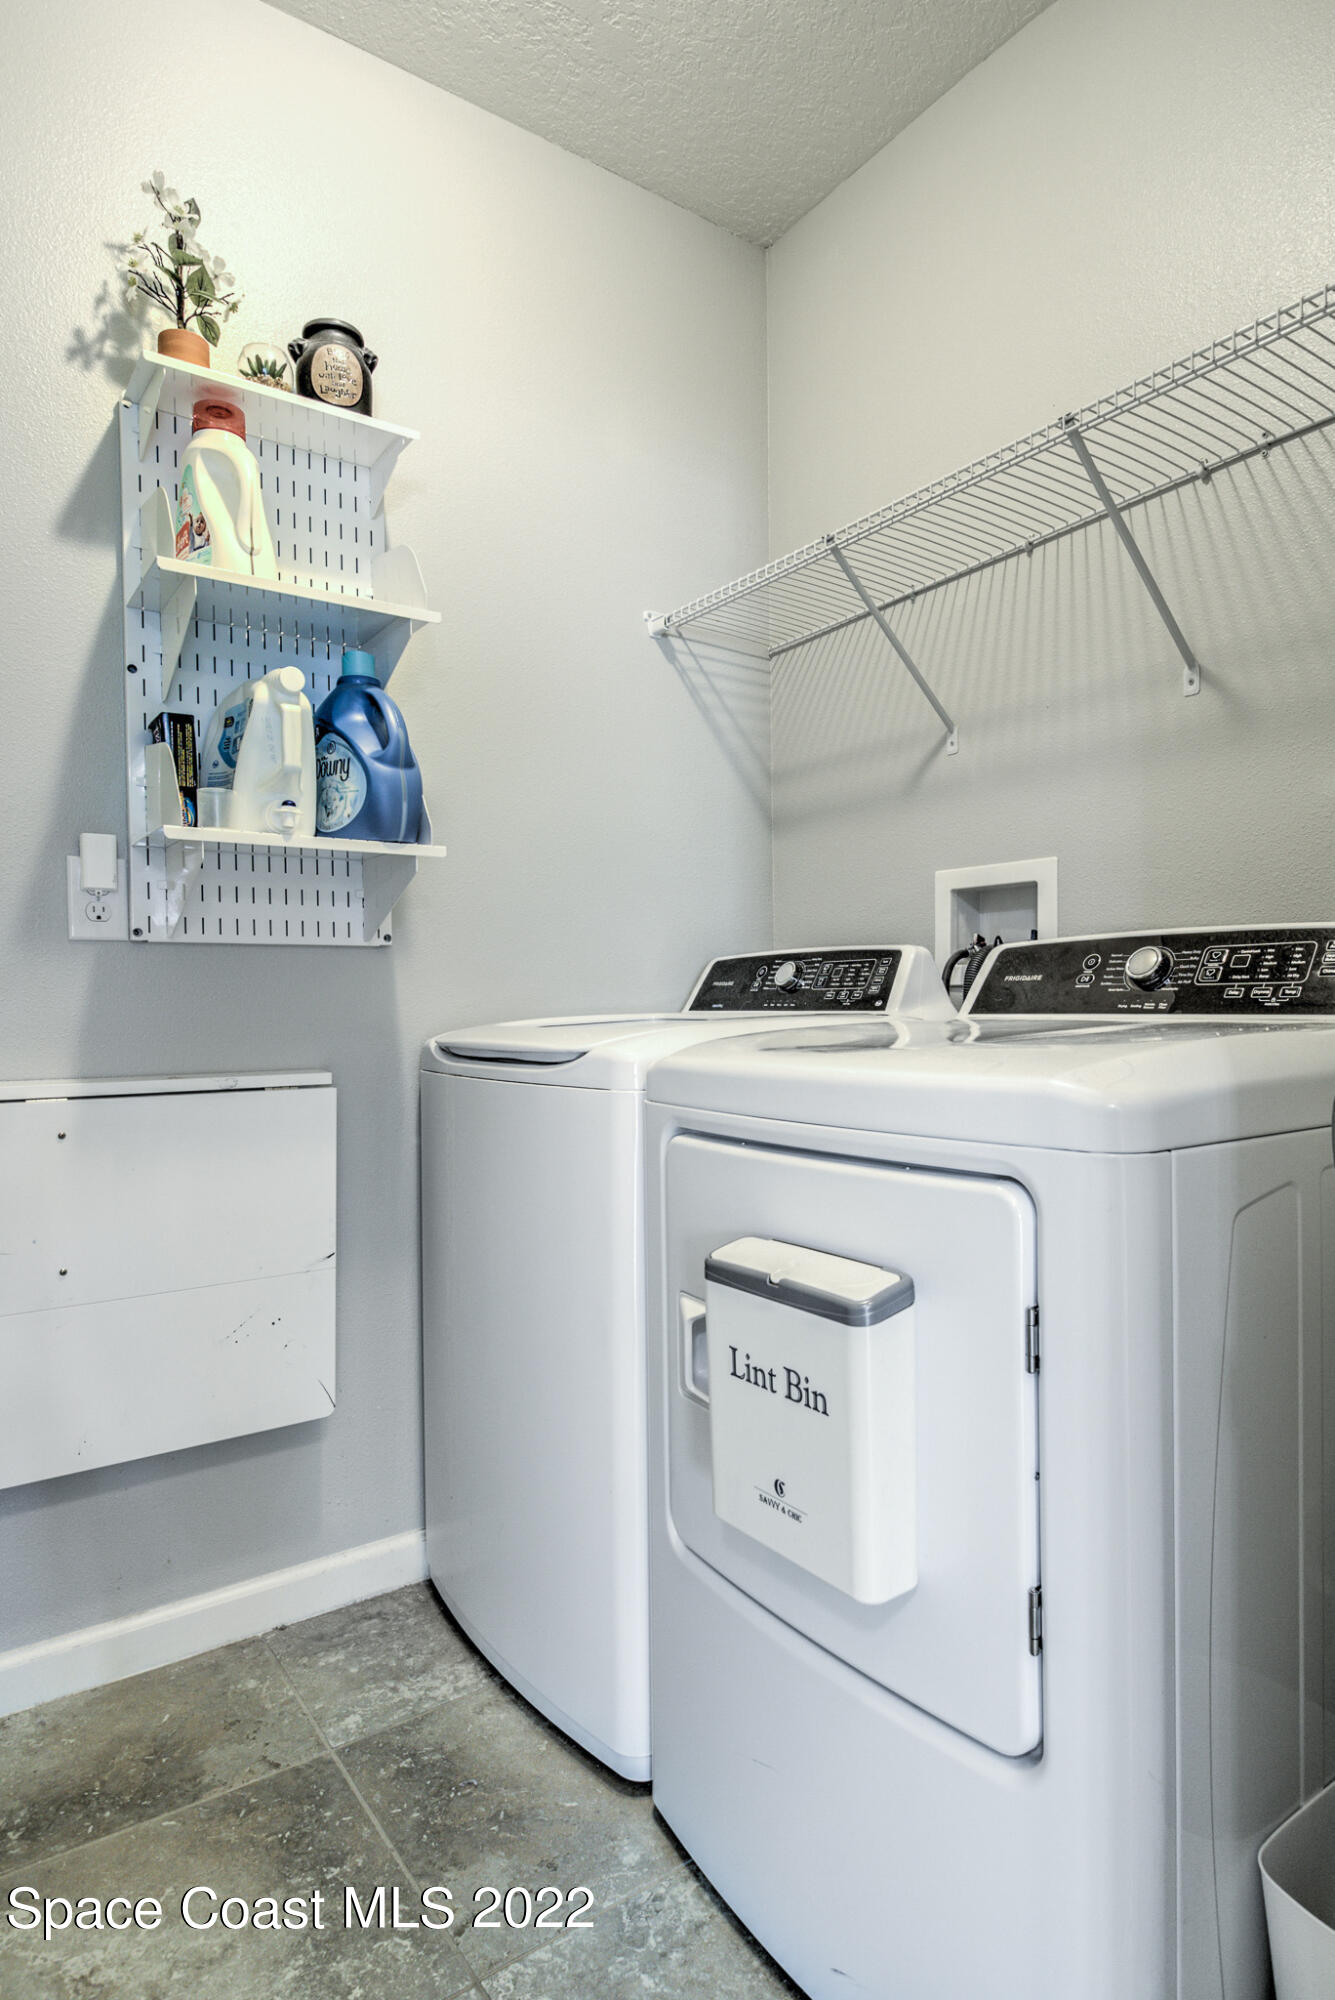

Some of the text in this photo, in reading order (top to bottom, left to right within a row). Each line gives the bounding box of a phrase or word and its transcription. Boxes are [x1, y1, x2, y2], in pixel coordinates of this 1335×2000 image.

[1004, 974, 1043, 982] FRIGIDAIRE
[729, 1344, 829, 1417] Lint Bin
[759, 1494, 781, 1511] SAVVY
